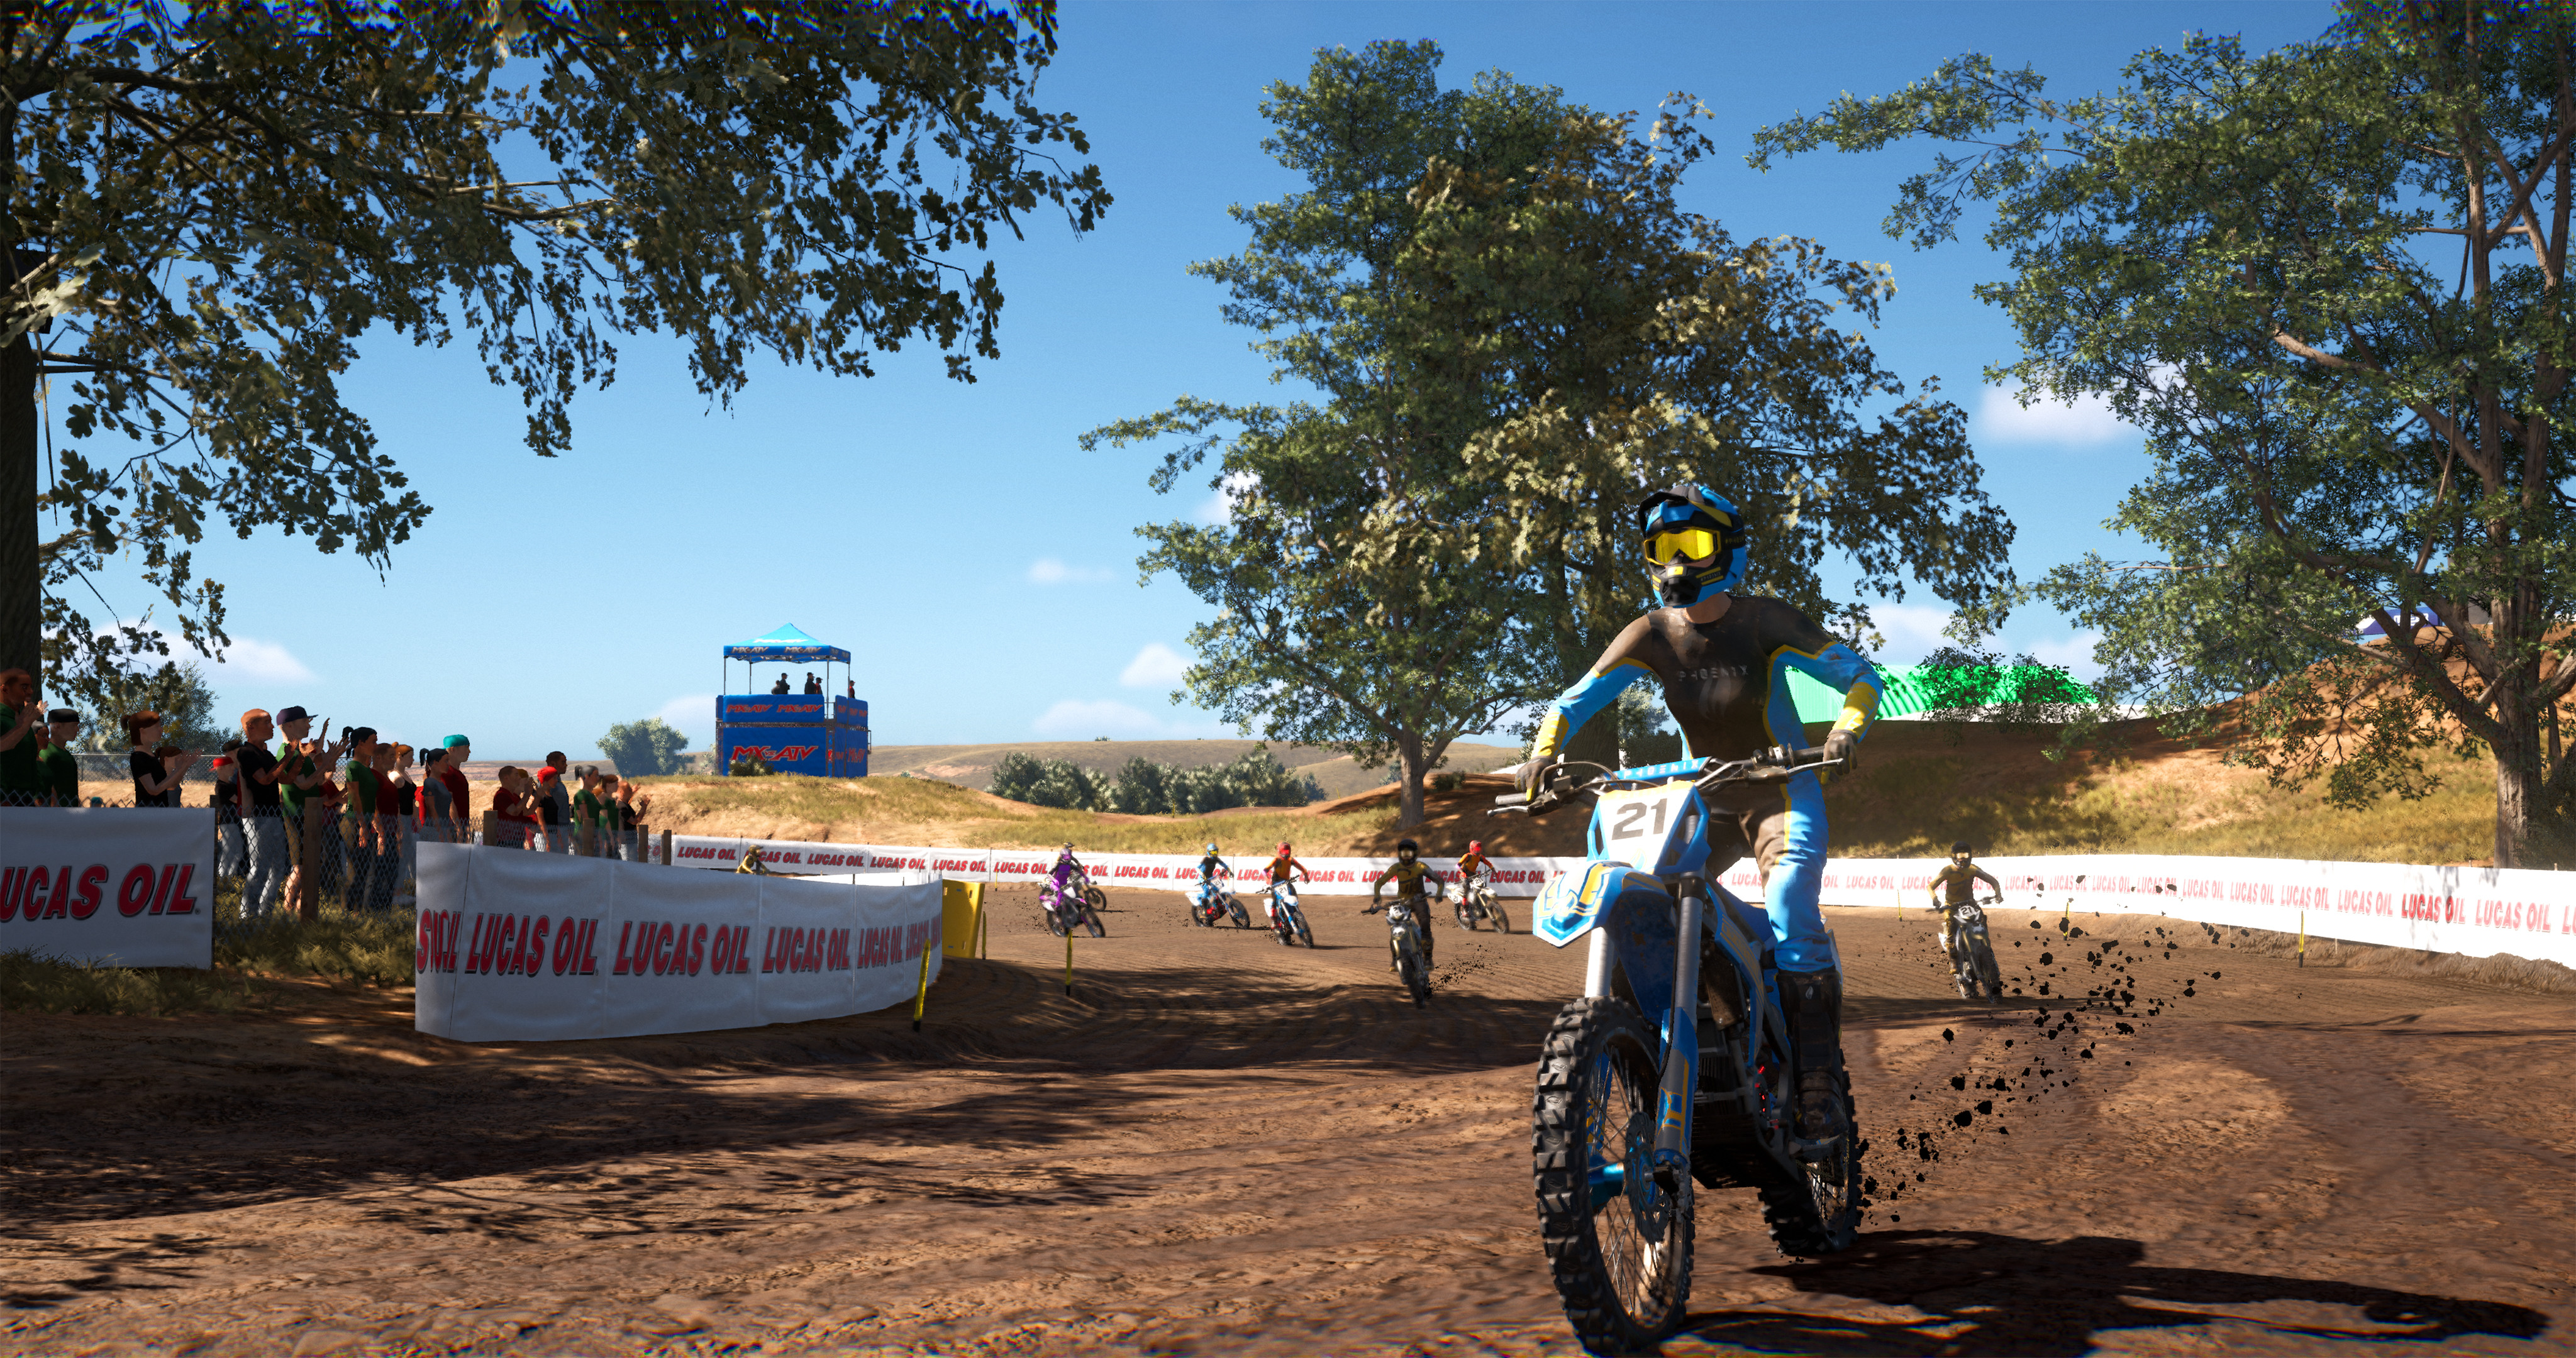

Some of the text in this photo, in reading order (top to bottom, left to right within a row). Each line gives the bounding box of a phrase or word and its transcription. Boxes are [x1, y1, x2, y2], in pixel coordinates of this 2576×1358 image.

[768, 746, 819, 761] ATV
[1611, 798, 1668, 841] 21
[677, 847, 736, 860] LUCAS OIL
[782, 851, 801, 863] OIL
[807, 853, 864, 866] LUCAS OIL
[870, 856, 926, 869] LUCAS OIL
[932, 859, 987, 872] LUCAS OIL
[994, 861, 1048, 874] LUCAS OIL
[1091, 864, 1109, 876] OIL
[1114, 866, 1169, 878] LUCAS OIL
[1337, 870, 1355, 883] OIL
[1489, 870, 1526, 883] LUCAS
[1528, 870, 1545, 883] OIL
[1823, 875, 1838, 889] OIL
[1845, 875, 1894, 890] LUCAS OIL
[2005, 875, 2029, 890] LUCAS
[2050, 875, 2073, 891] LUCAS
[2092, 875, 2131, 893] LUCAS OIL
[2182, 878, 2224, 900] LUCAS OIL
[0, 863, 196, 922] UCAS OIL
[2230, 881, 2274, 905] LUCAS OIL
[2280, 885, 2330, 910] LUCAS OIL
[1961, 906, 1972, 915] 21
[2337, 889, 2394, 917] LUCAS OIL
[2401, 893, 2466, 924] LUCAS OIL
[2475, 899, 2522, 931] LUCAS
[2525, 902, 2551, 933] OIL
[465, 912, 550, 978] LUCAS
[552, 916, 598, 976] OIL
[613, 920, 750, 977] LUCAS OIL
[761, 926, 850, 973] LUCAS OIL
[857, 926, 890, 969] LUCAS
[890, 925, 902, 966] OIL
